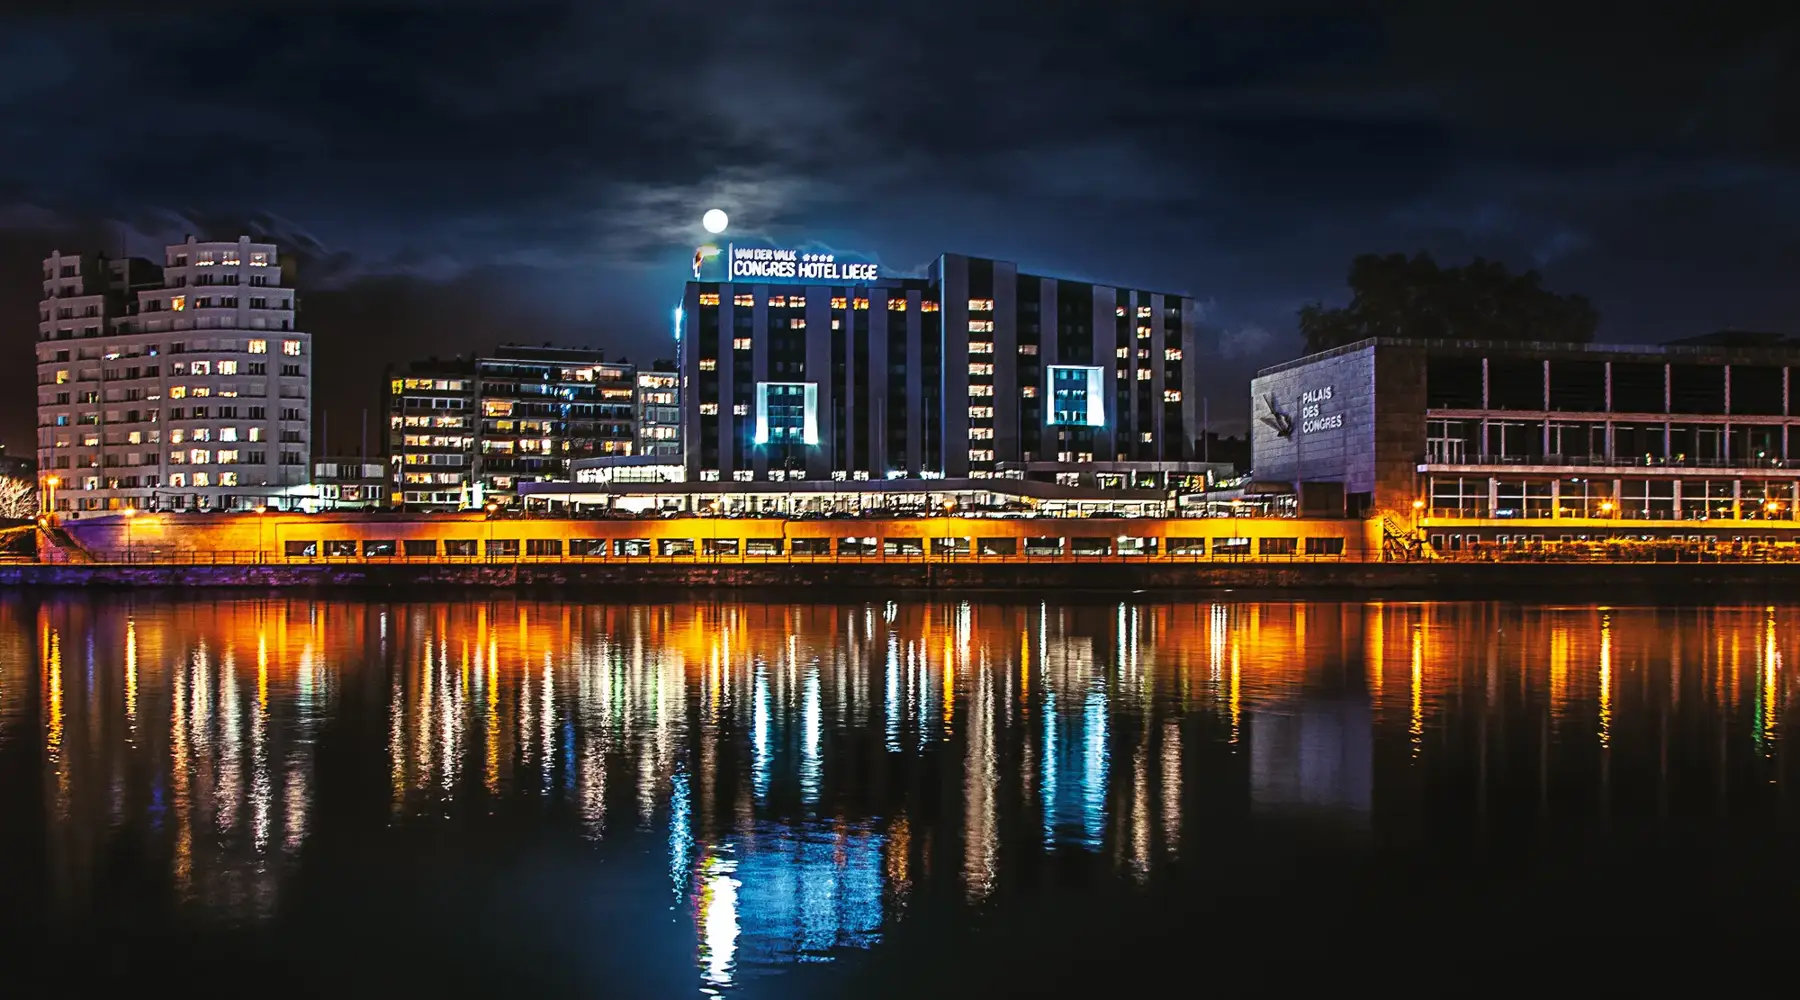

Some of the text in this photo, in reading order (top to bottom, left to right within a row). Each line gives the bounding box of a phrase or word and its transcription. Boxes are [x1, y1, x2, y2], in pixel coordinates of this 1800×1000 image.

[735, 249, 797, 261] VAN DER VALK
[733, 260, 878, 280] CONGRES HOTEL LIEGE
[1302, 386, 1332, 404] PALAIS
[1302, 404, 1319, 419] DES
[1302, 414, 1343, 433] CONGRES
